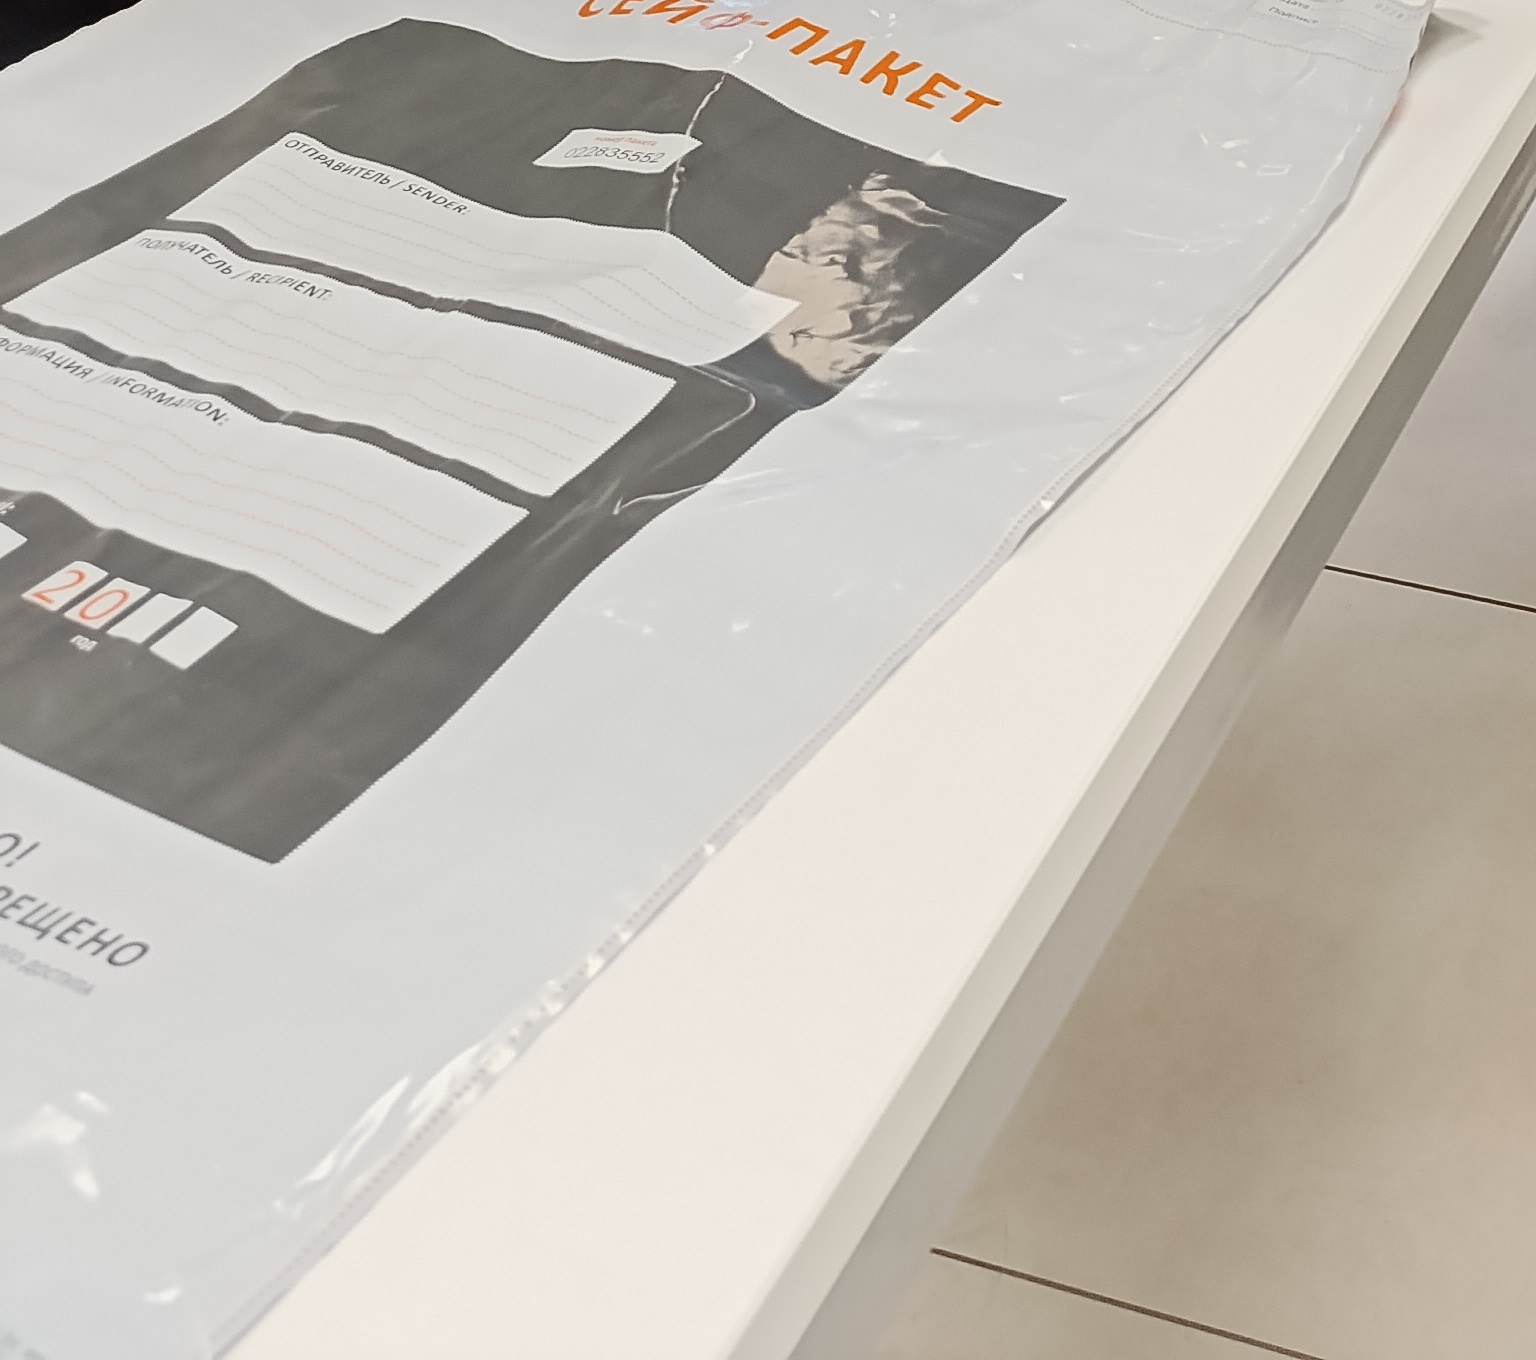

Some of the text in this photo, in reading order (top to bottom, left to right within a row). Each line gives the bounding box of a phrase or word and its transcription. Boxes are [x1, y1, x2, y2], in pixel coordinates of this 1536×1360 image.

[284, 138, 391, 186] ОТПРАВИТЕЛЬ
[403, 182, 471, 216] SENDER:
[135, 236, 234, 276] ПОЛУЧАТЕЛЬ
[246, 270, 334, 301] RECIPIENT:
[103, 372, 230, 427] INFORMATION:
